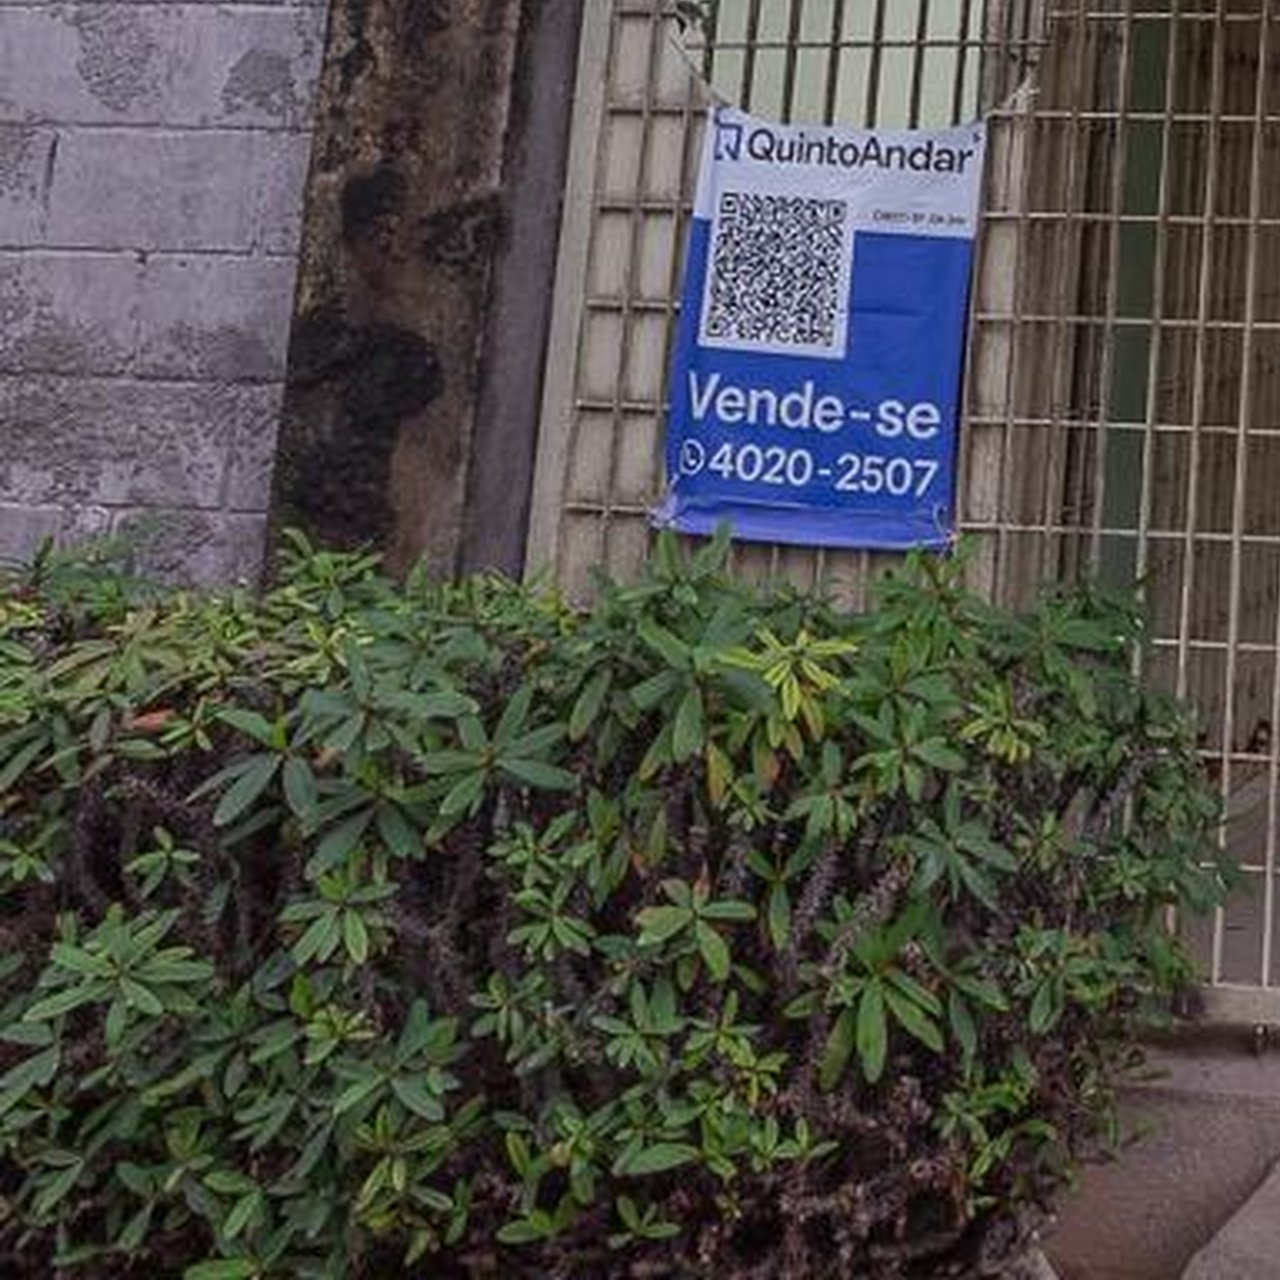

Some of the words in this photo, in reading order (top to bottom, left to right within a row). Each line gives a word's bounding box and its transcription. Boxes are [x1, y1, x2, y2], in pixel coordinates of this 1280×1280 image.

[746, 128, 974, 173] QuintoAndar
[688, 371, 941, 440] Vende-se
[708, 444, 938, 495] 4020-2507
